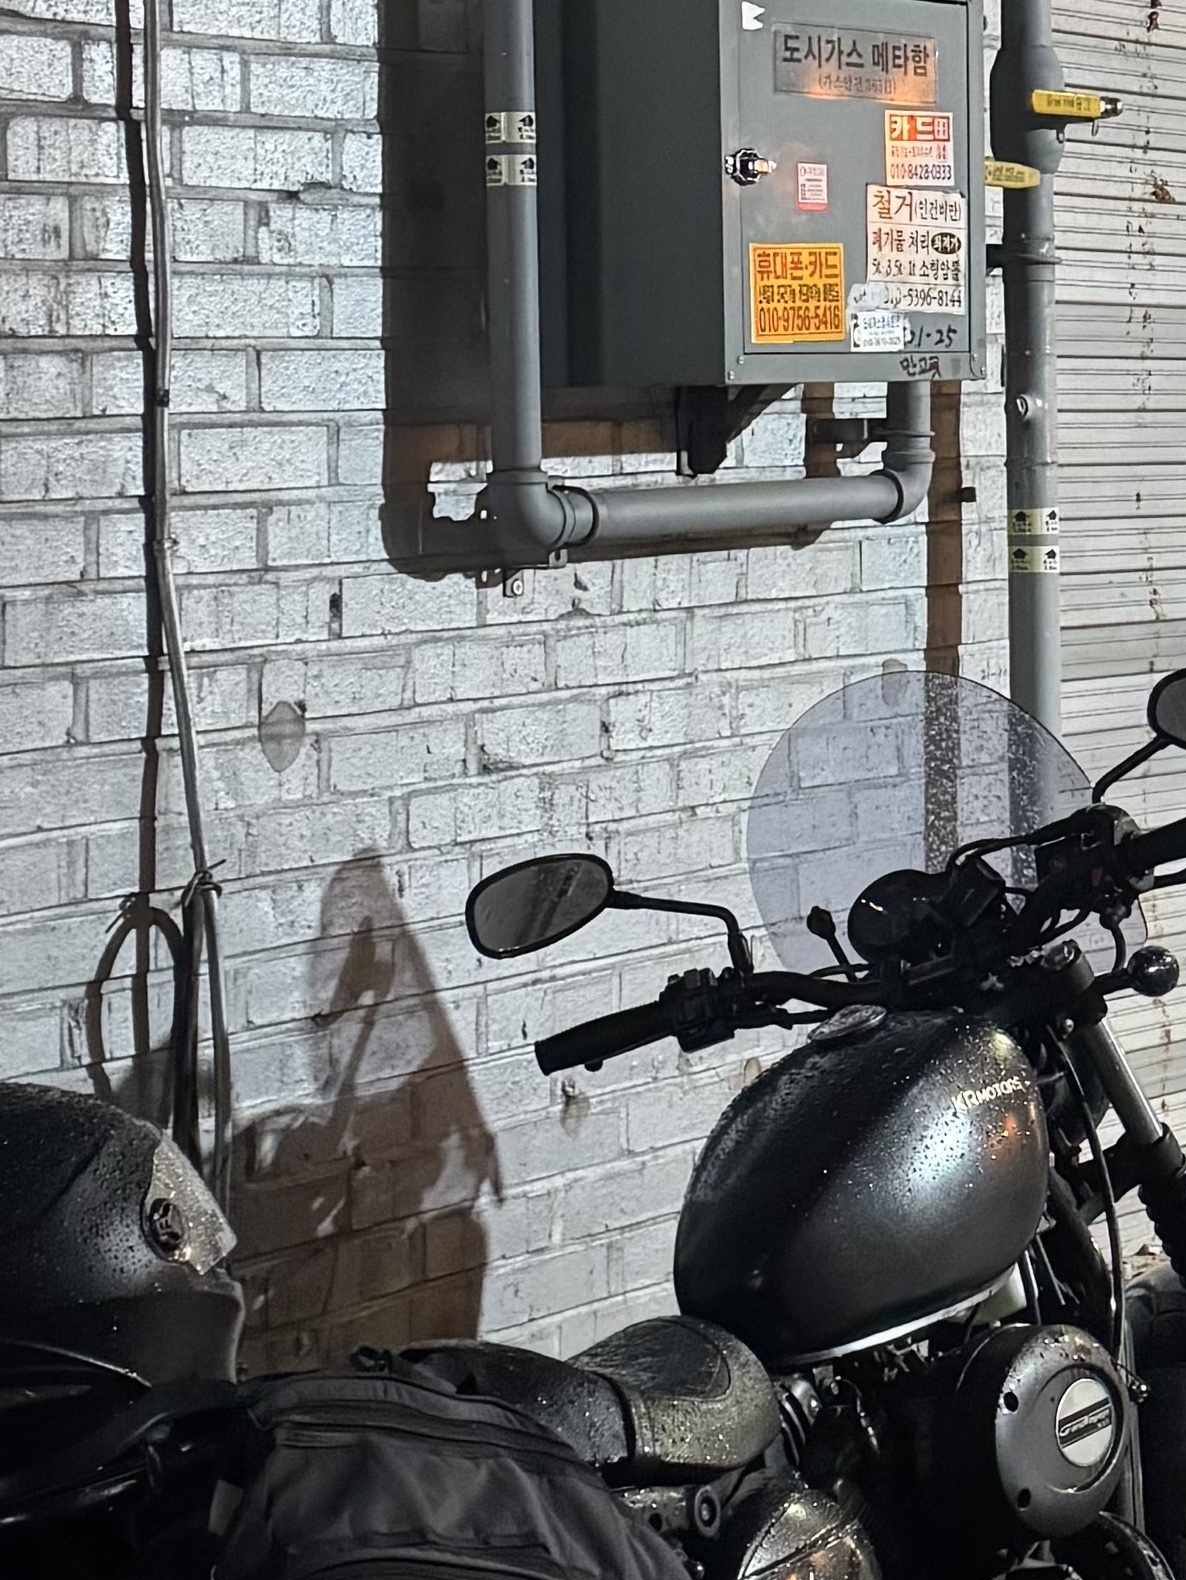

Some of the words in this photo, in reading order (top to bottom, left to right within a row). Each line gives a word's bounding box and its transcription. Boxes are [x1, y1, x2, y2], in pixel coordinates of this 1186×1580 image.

[782, 34, 864, 69] 도시가스
[872, 41, 930, 77] 메타함
[872, 190, 913, 222] 철거
[908, 230, 930, 255] 처리
[759, 305, 840, 332] 010-9756-5416
